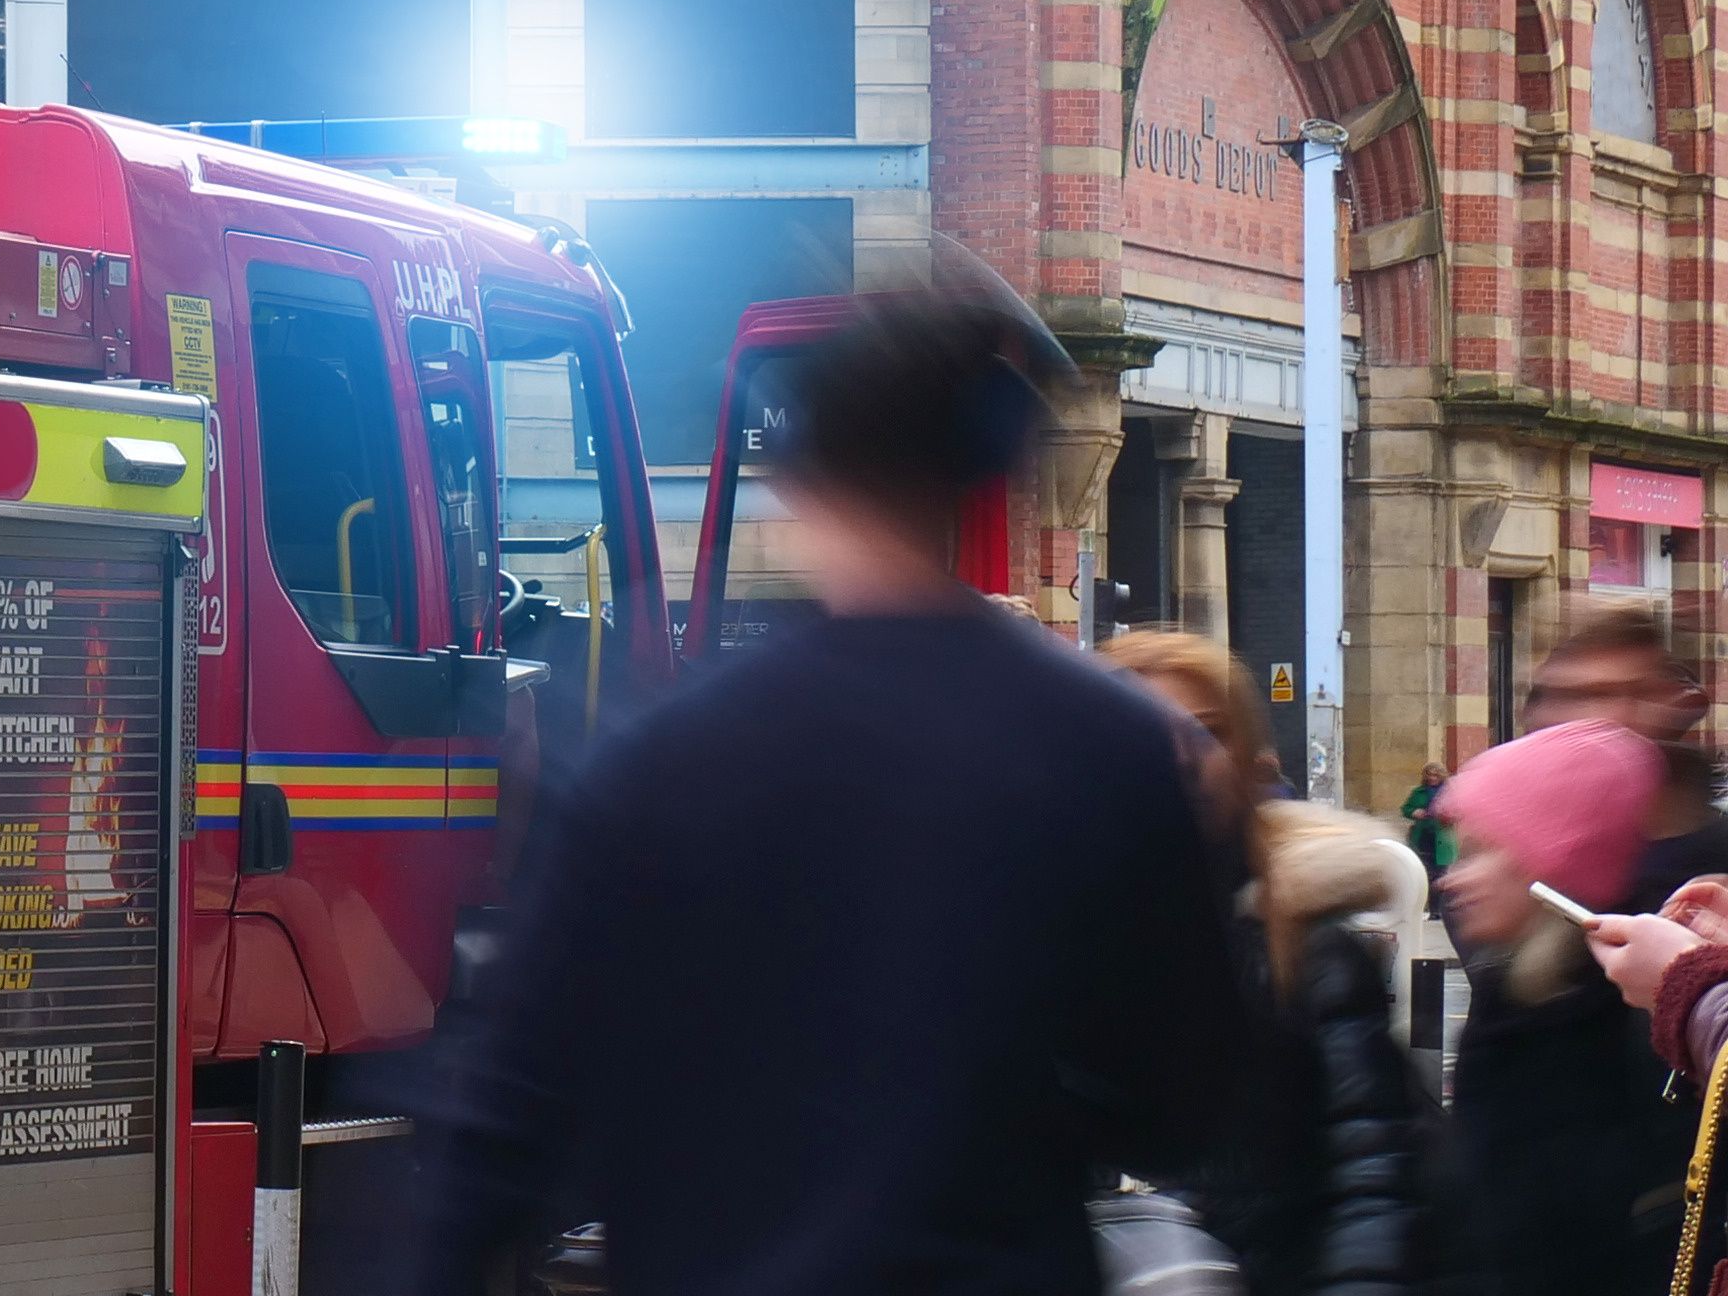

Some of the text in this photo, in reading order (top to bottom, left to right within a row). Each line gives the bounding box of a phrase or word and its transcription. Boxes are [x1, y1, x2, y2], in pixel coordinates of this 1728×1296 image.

[1135, 118, 1278, 202] GOODS DEPOT
[24, 580, 53, 630] OF
[35, 1046, 93, 1092] HOME
[0, 1103, 132, 1156] ASSESSMENT
